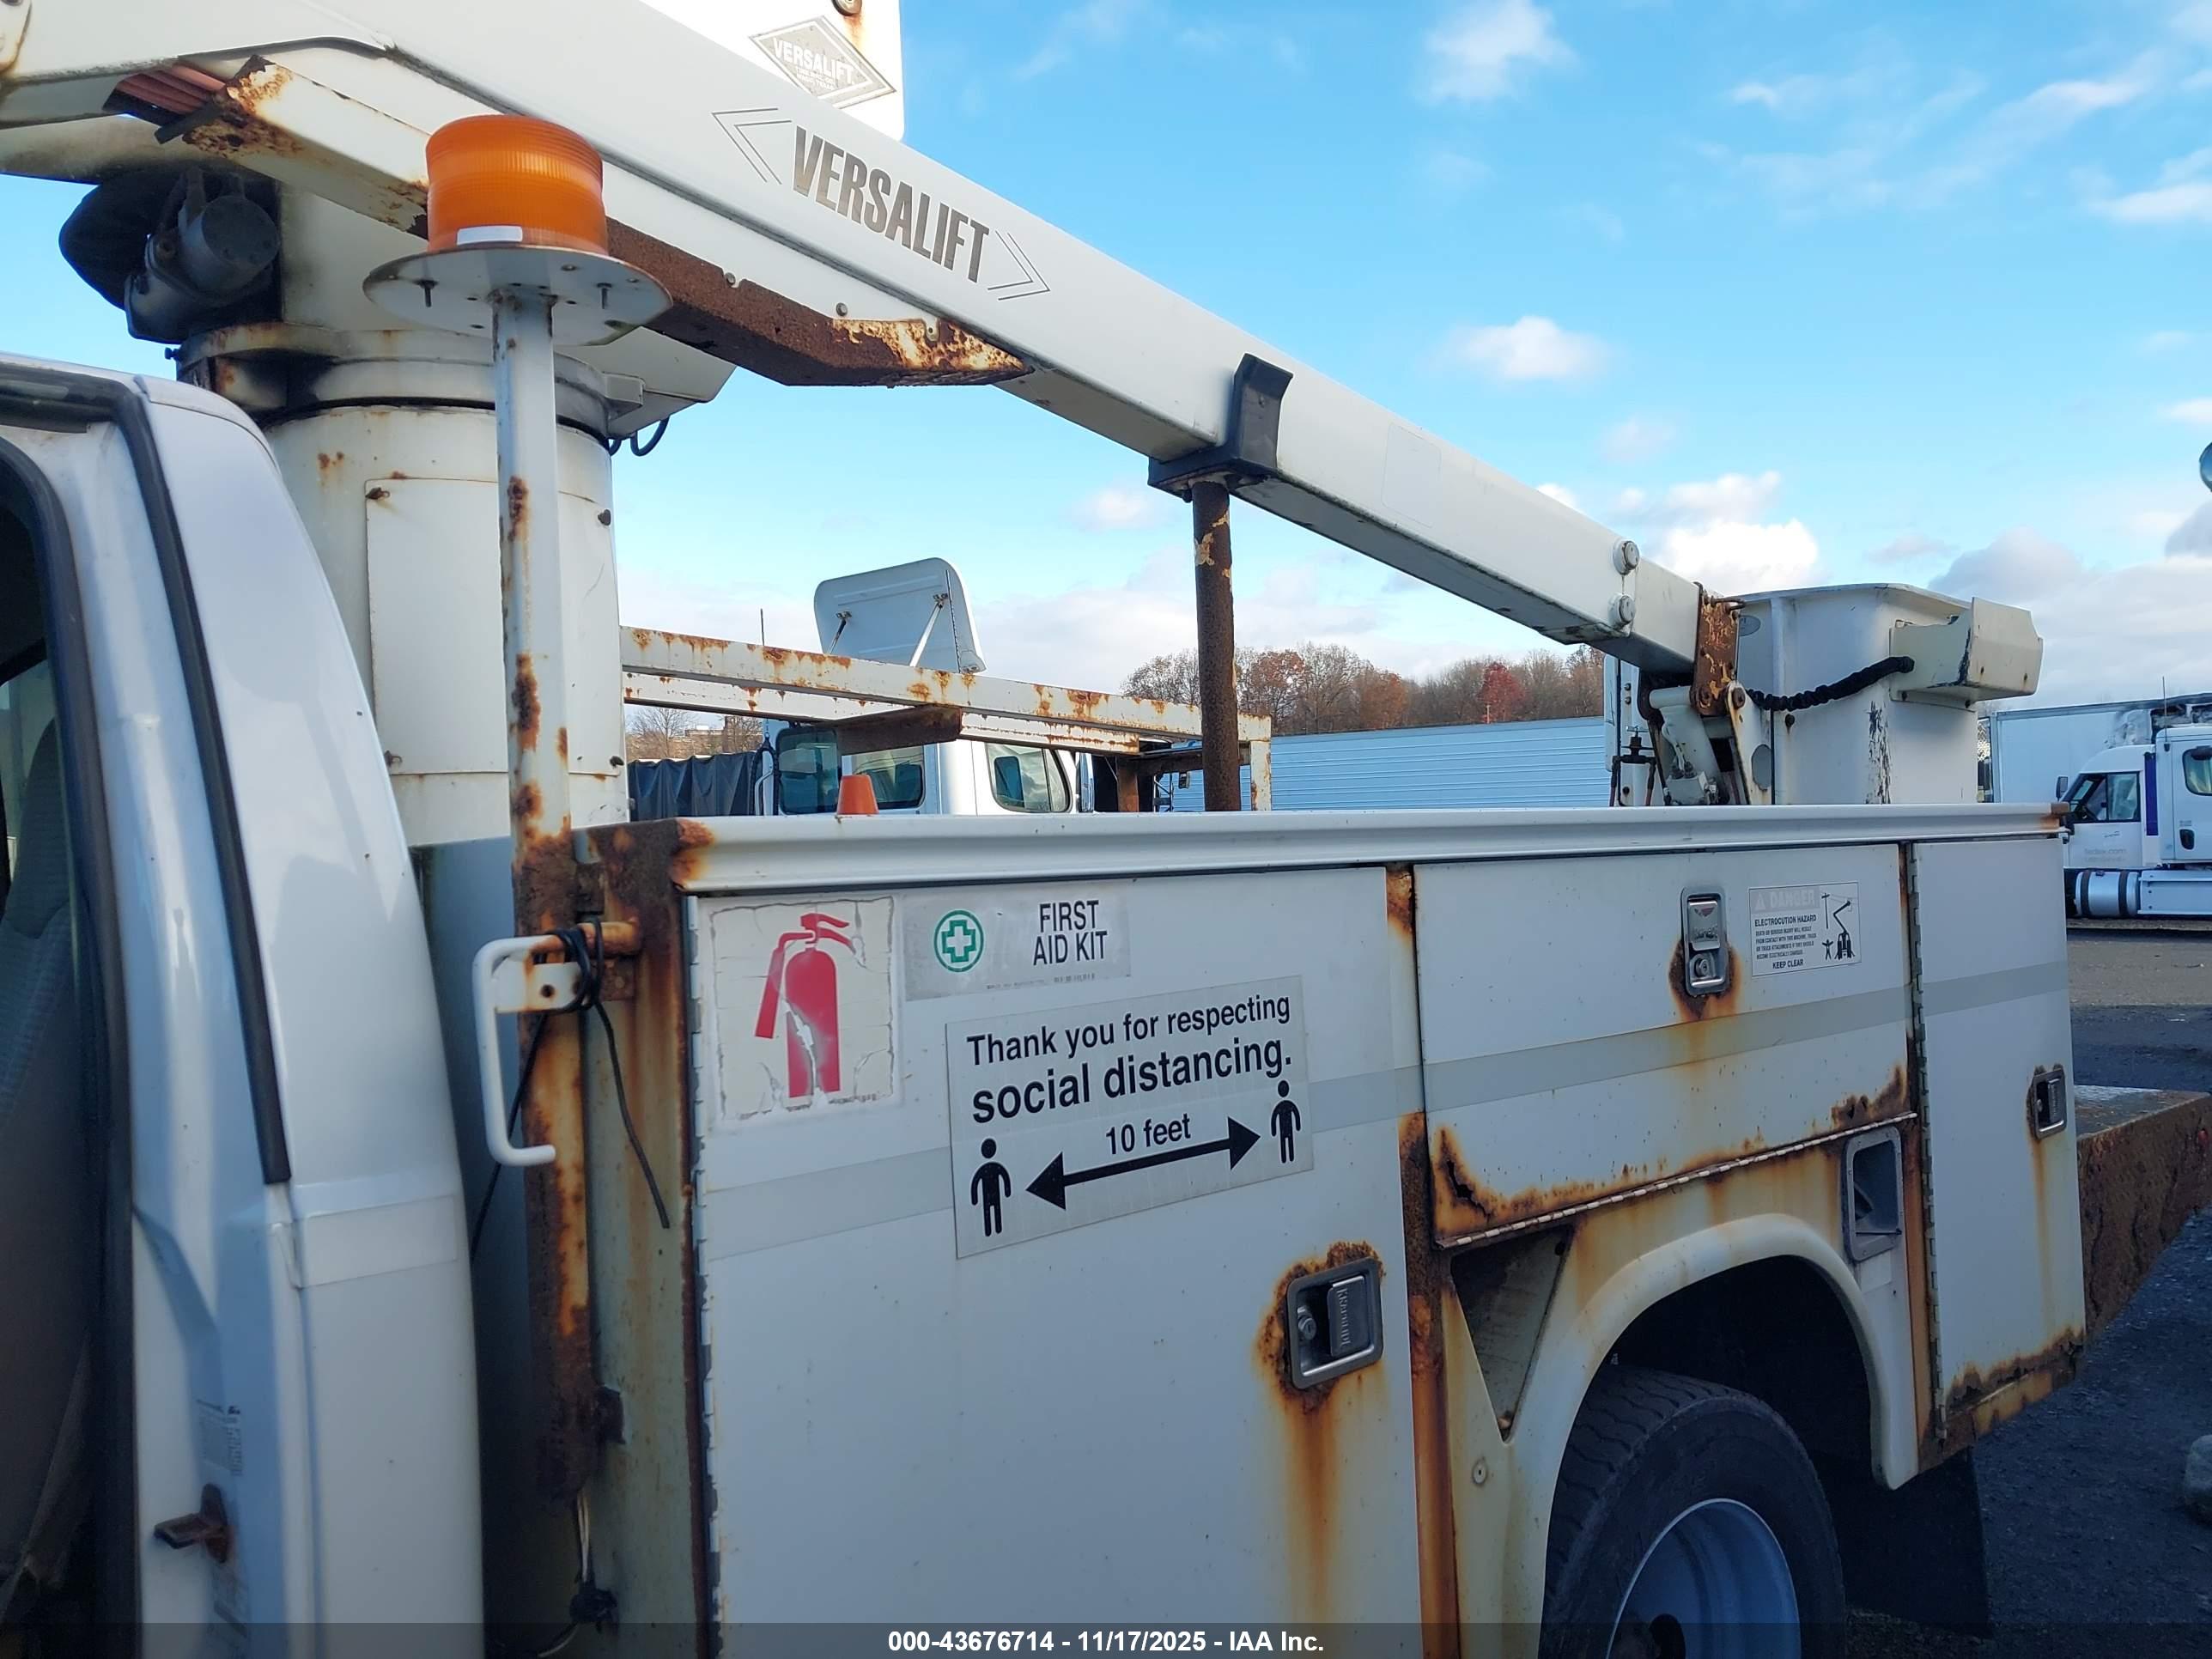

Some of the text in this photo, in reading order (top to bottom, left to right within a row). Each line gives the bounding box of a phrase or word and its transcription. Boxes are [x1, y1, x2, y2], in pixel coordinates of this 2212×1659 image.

[793, 125, 990, 284] VERSALIFT
[1039, 899, 1099, 933] FIRST
[1754, 914, 1817, 927] ELECTROCUTION HAZARD
[1033, 930, 1108, 966] AID KIT
[1771, 958, 1804, 969] KEEP CLEAR
[967, 994, 1291, 1067] Thank you for respecting
[972, 1037, 1292, 1124] social distancing.
[1105, 1113, 1192, 1156] 10 feet
